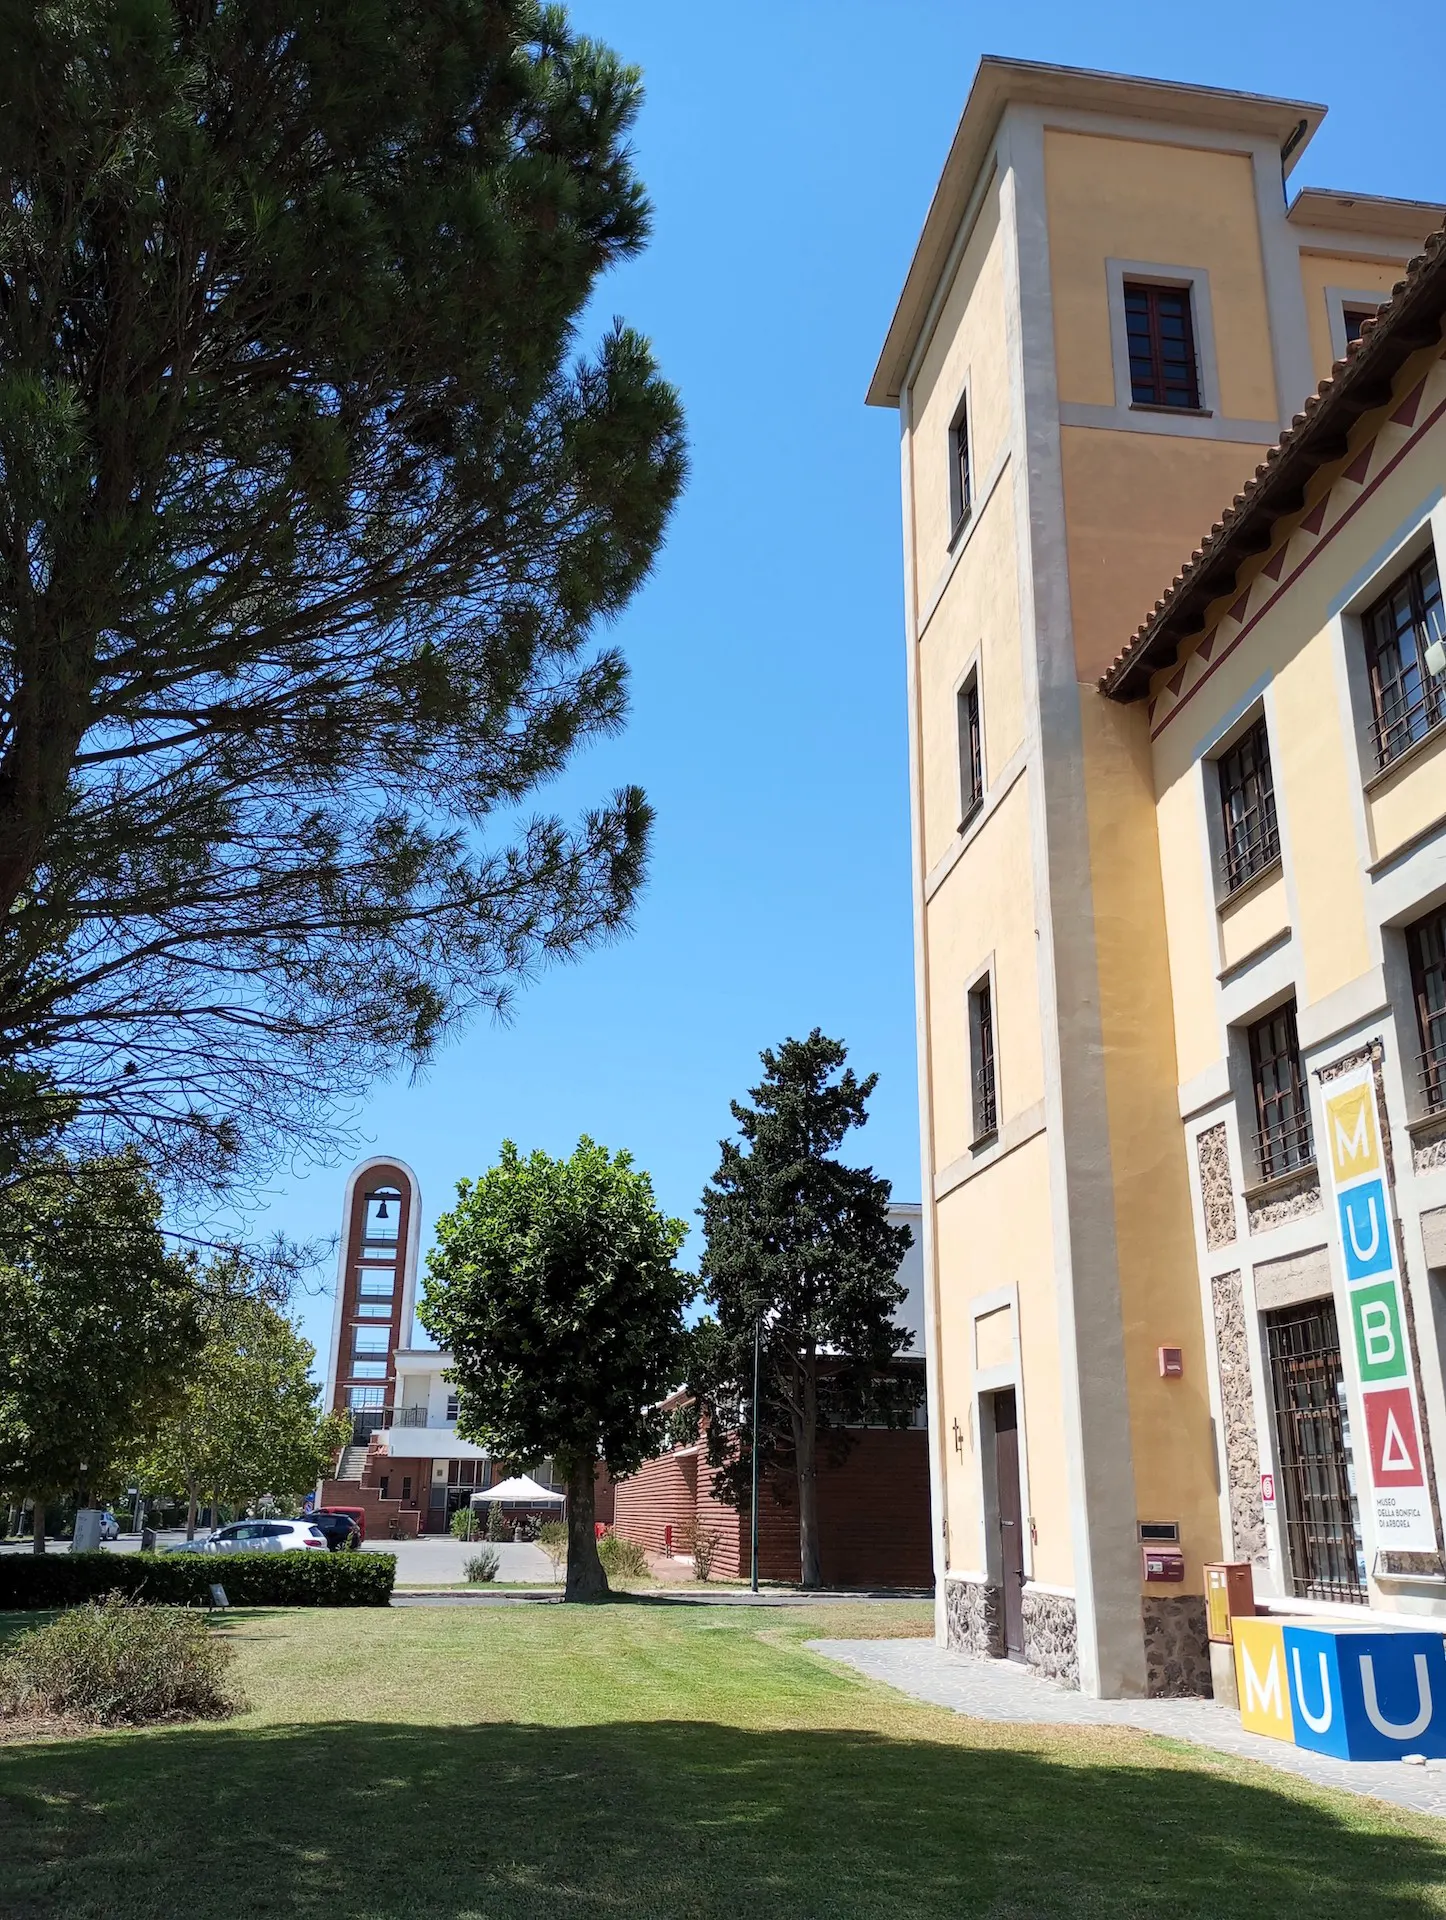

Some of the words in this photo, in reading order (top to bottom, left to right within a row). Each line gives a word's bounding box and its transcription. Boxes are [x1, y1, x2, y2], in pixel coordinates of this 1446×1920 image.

[1376, 1497, 1397, 1506] MUSEO
[1377, 1508, 1395, 1517] DELLA
[1386, 1519, 1411, 1528] ARBOREA
